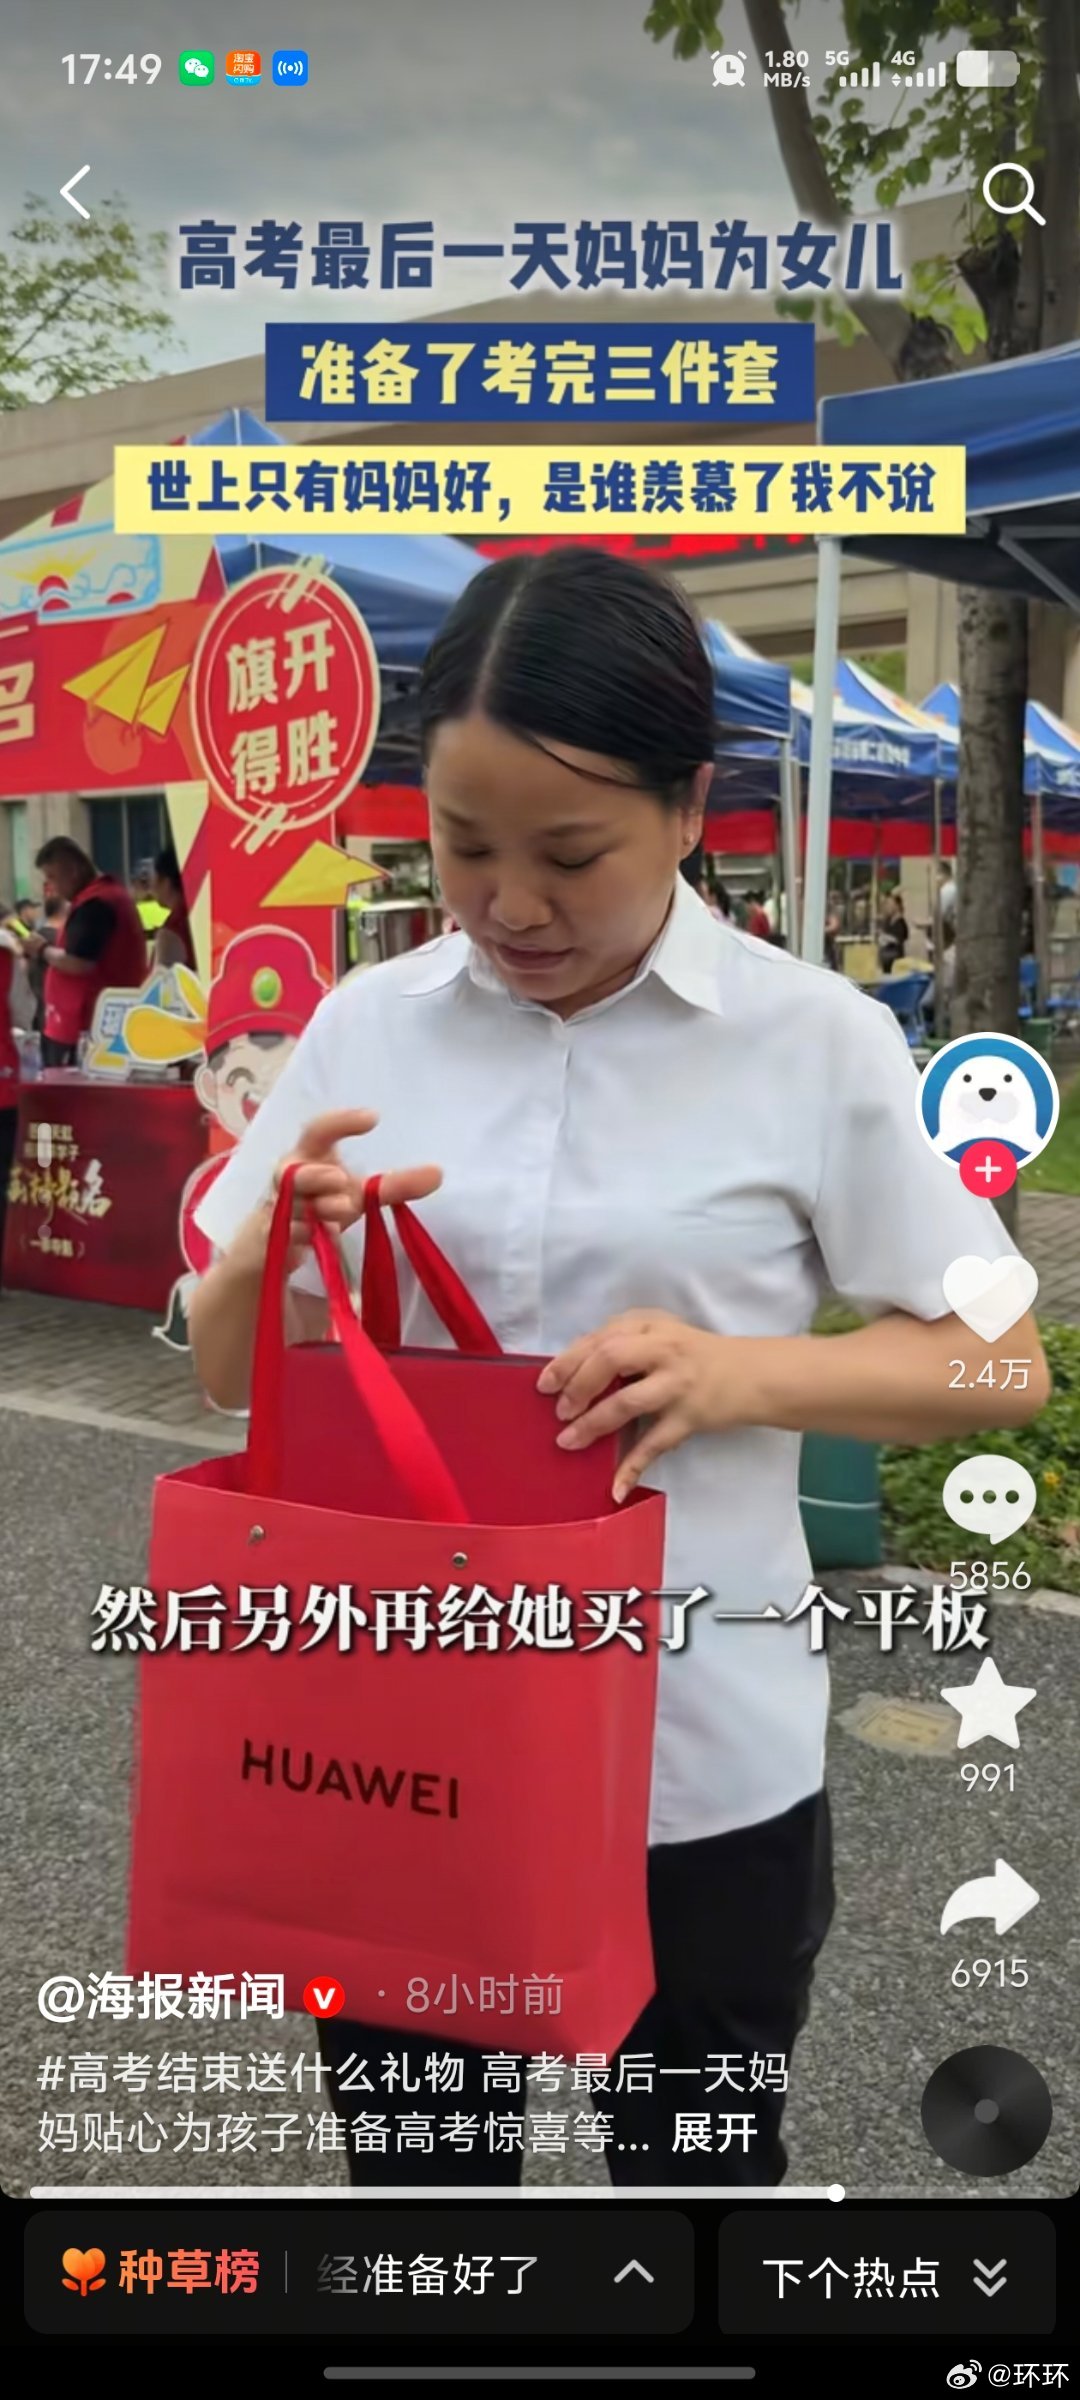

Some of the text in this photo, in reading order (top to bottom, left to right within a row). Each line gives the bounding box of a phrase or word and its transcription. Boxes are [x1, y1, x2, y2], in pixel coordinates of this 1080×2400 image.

[225, 619, 336, 715] 旗开
[231, 710, 340, 801] 得胜
[241, 1739, 460, 1820] HUAWEI
